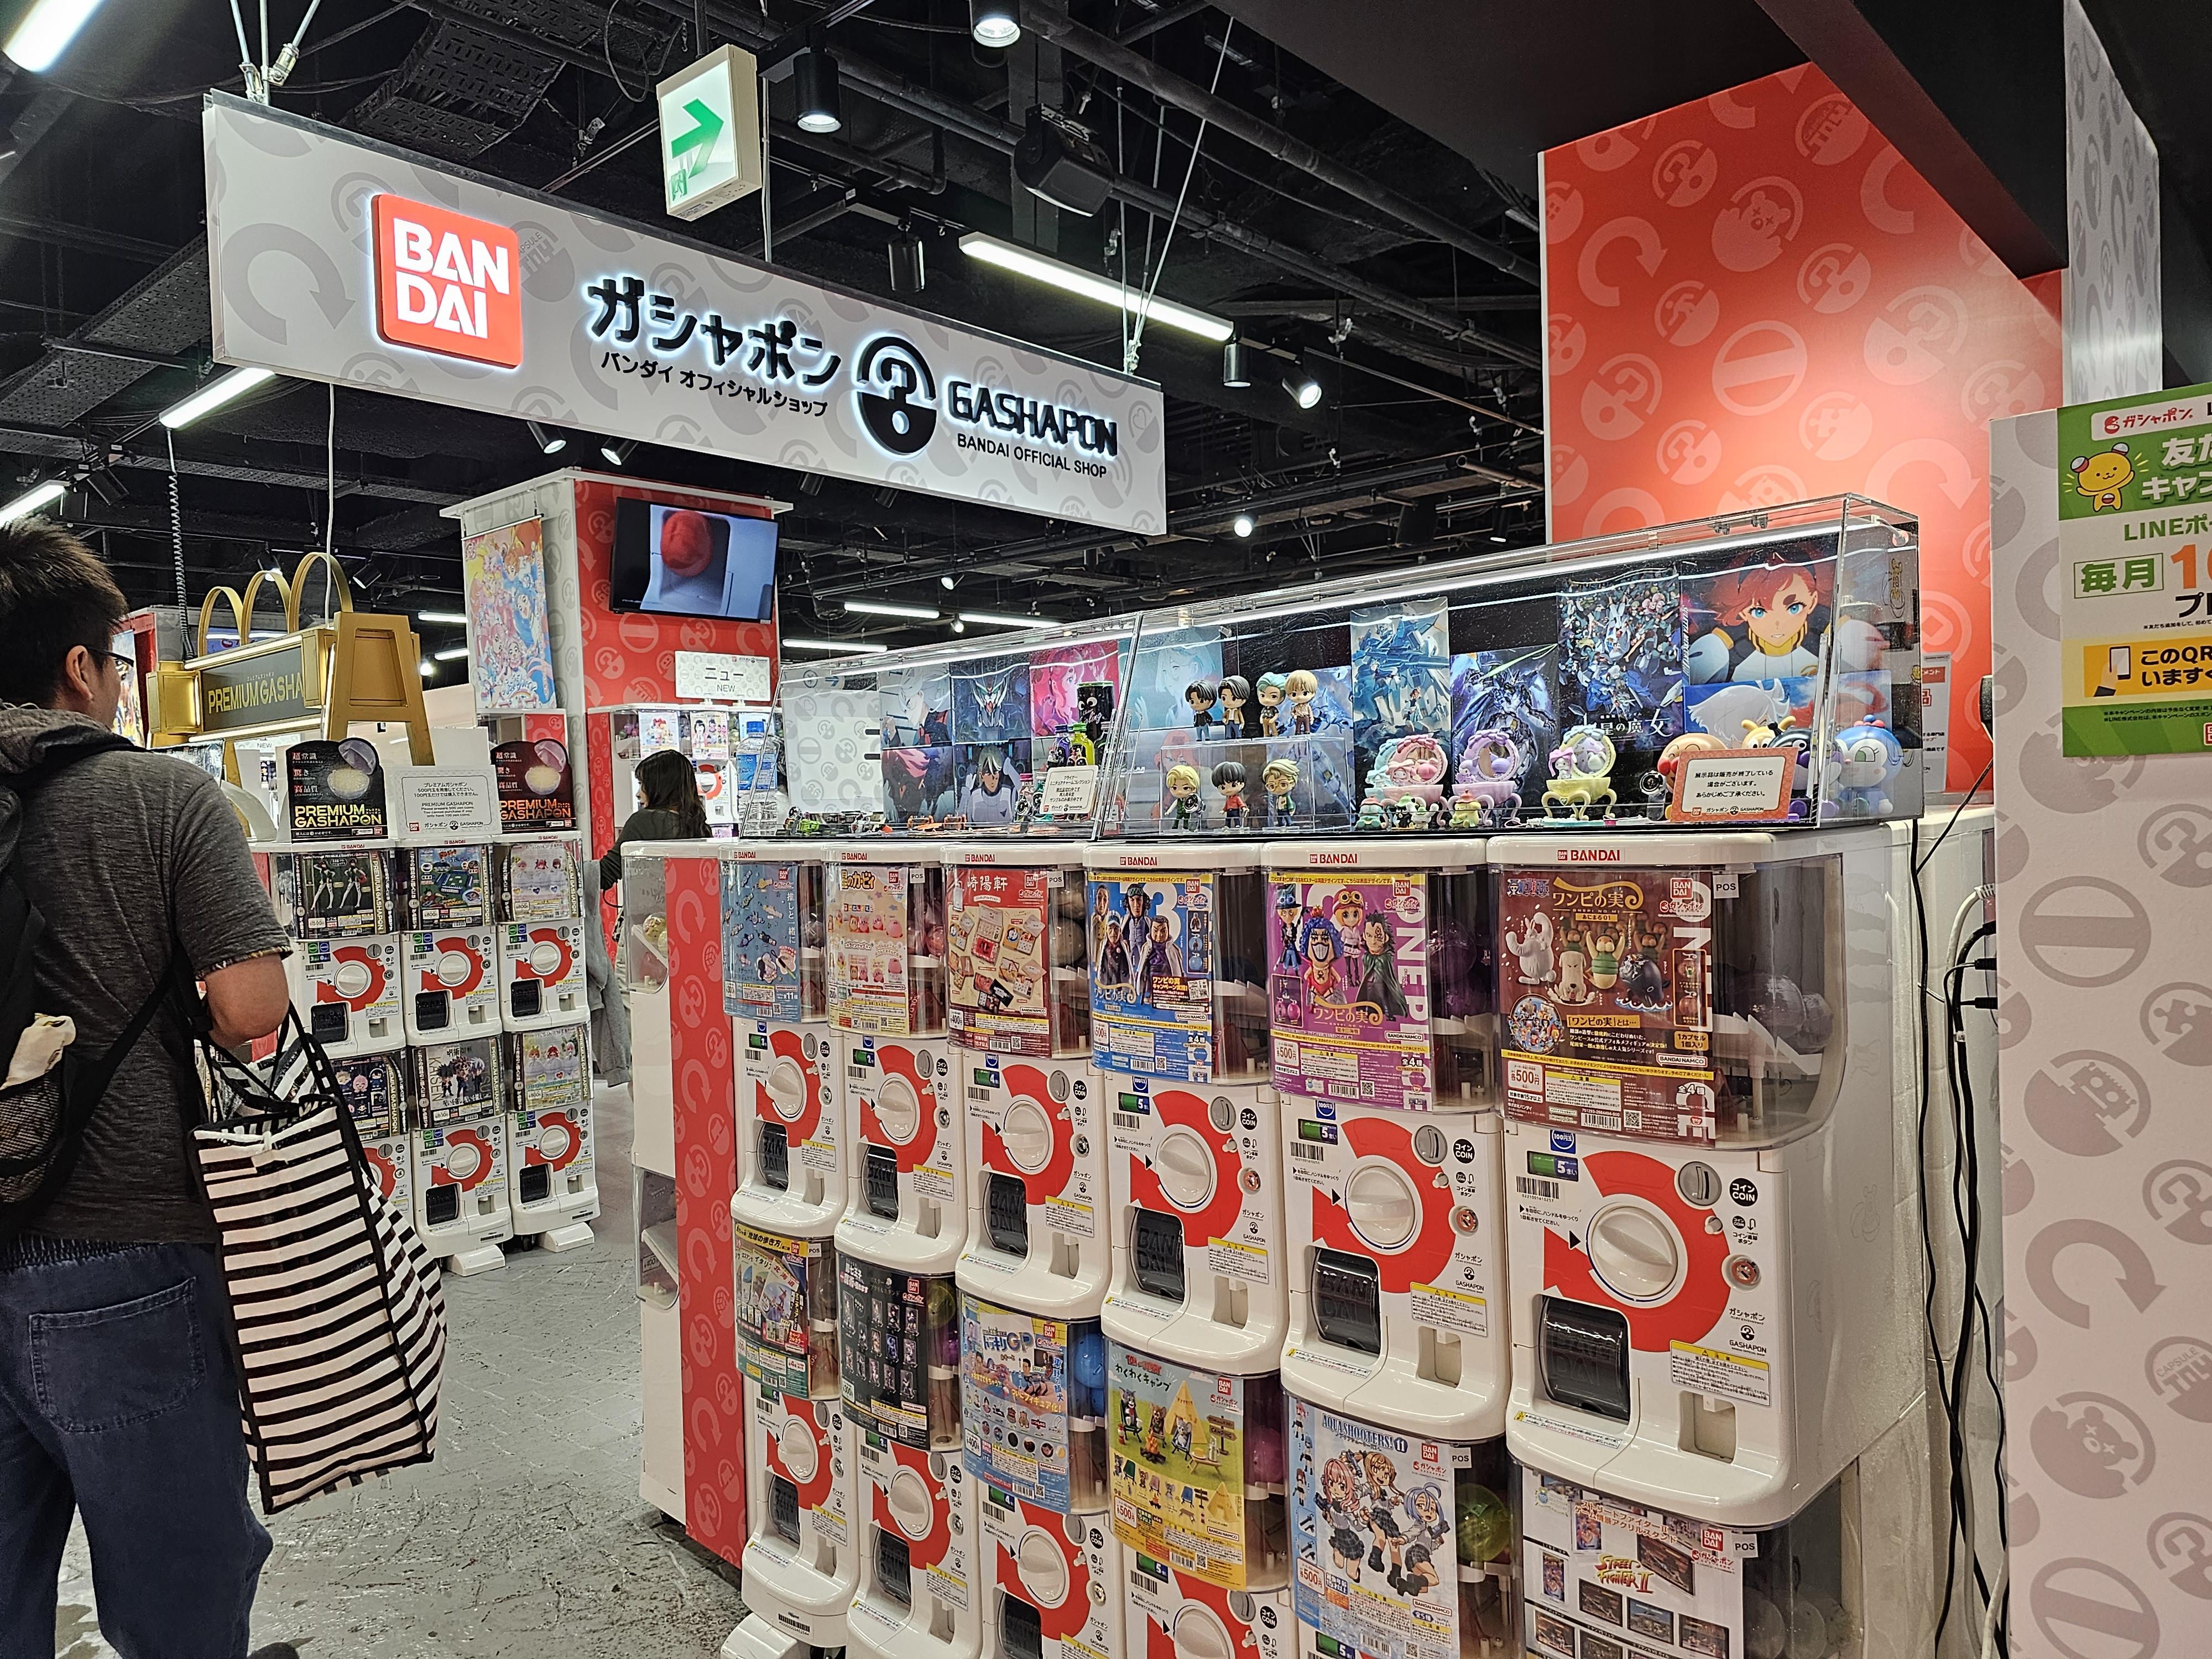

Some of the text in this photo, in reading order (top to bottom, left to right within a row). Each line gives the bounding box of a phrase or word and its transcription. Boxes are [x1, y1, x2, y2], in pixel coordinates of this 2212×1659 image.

[394, 218, 509, 295] BAN
[396, 272, 488, 339] DAI
[587, 276, 842, 386] ガシャポン
[601, 351, 828, 418] バンダイ オフィシャルショップ
[948, 380, 1118, 457] GASHAPON
[2122, 408, 2193, 428] ガシャポン
[957, 434, 1107, 479] BANDAI OFFICIAL SHOP
[2124, 514, 2212, 541] LINEポ
[2081, 558, 2155, 592] 毎月
[705, 667, 744, 681] ニュー
[208, 681, 259, 714] PREMIUM
[1694, 770, 1774, 779] 展示品は販売が終了している
[295, 804, 365, 817] PREMIUM
[499, 799, 557, 811] PREMIUM
[500, 808, 571, 820] GASHAPON
[295, 814, 382, 828] GASHAPON
[847, 852, 868, 860] BANDAI
[971, 854, 995, 863] BANDAI
[1319, 853, 1358, 864] BANDAI
[1571, 849, 1620, 861] BANDAI
[1127, 857, 1157, 867] BANDAI
[967, 874, 1008, 891] 崎陽軒
[1715, 883, 1736, 892] POS
[372, 860, 384, 930] PREMIUM GASHAPON
[1552, 891, 1625, 908] ワンピの実
[786, 892, 797, 943] 推しと一緒に
[1313, 1008, 1369, 1024] ワンピの実
[1677, 1033, 1707, 1042] 1カプセル
[1402, 1057, 1423, 1067] 全4種
[387, 1064, 398, 1133] PREMIUM GASHAPON
[1241, 1118, 1256, 1127] COIN
[1554, 1133, 1572, 1142] 100円玉
[1455, 1143, 1473, 1151] コイン
[1455, 1150, 1473, 1160] COIN
[1073, 1171, 1092, 1179] ガシャポン
[1731, 1183, 1755, 1193] コイン
[1732, 1192, 1756, 1202] COIN
[1242, 1209, 1264, 1218] ガシャポン
[1137, 1227, 1176, 1256] BAN
[1243, 1234, 1266, 1244] GASHAPON
[1137, 1250, 1167, 1275] DAI
[1455, 1252, 1483, 1264] ガシャポン
[773, 1264, 795, 1288] 北海道
[1455, 1280, 1484, 1291] GASHAPON
[1729, 1308, 1765, 1321] ガシャポン
[1729, 1340, 1767, 1354] GASHAPON
[2156, 1347, 2199, 1377] CAPSULE
[1115, 1363, 1171, 1392] わくわくキャンプ
[1011, 1389, 1061, 1412] ついにフィギュア化!
[1216, 1396, 1238, 1405] ガシャポン
[1211, 1427, 1233, 1438] CAMPING
[1322, 1413, 1407, 1453] AQUA SHOOTERS! 11
[1422, 1444, 1438, 1454] BAN
[1422, 1452, 1435, 1460] DAI
[1452, 1454, 1469, 1463] POS
[1421, 1462, 1447, 1475] ガシャポン
[1091, 1535, 1103, 1546] COIN
[1704, 1530, 1722, 1541] BAN
[1704, 1538, 1718, 1548] DAI
[1734, 1542, 1755, 1551] POS
[1595, 1554, 1642, 1571] STREET
[1597, 1570, 1639, 1589] FIGHTER
[1261, 1609, 1276, 1618] コイン
[1415, 1601, 1451, 1614] BANDAI NAMCO
[1261, 1615, 1276, 1626] COIN
